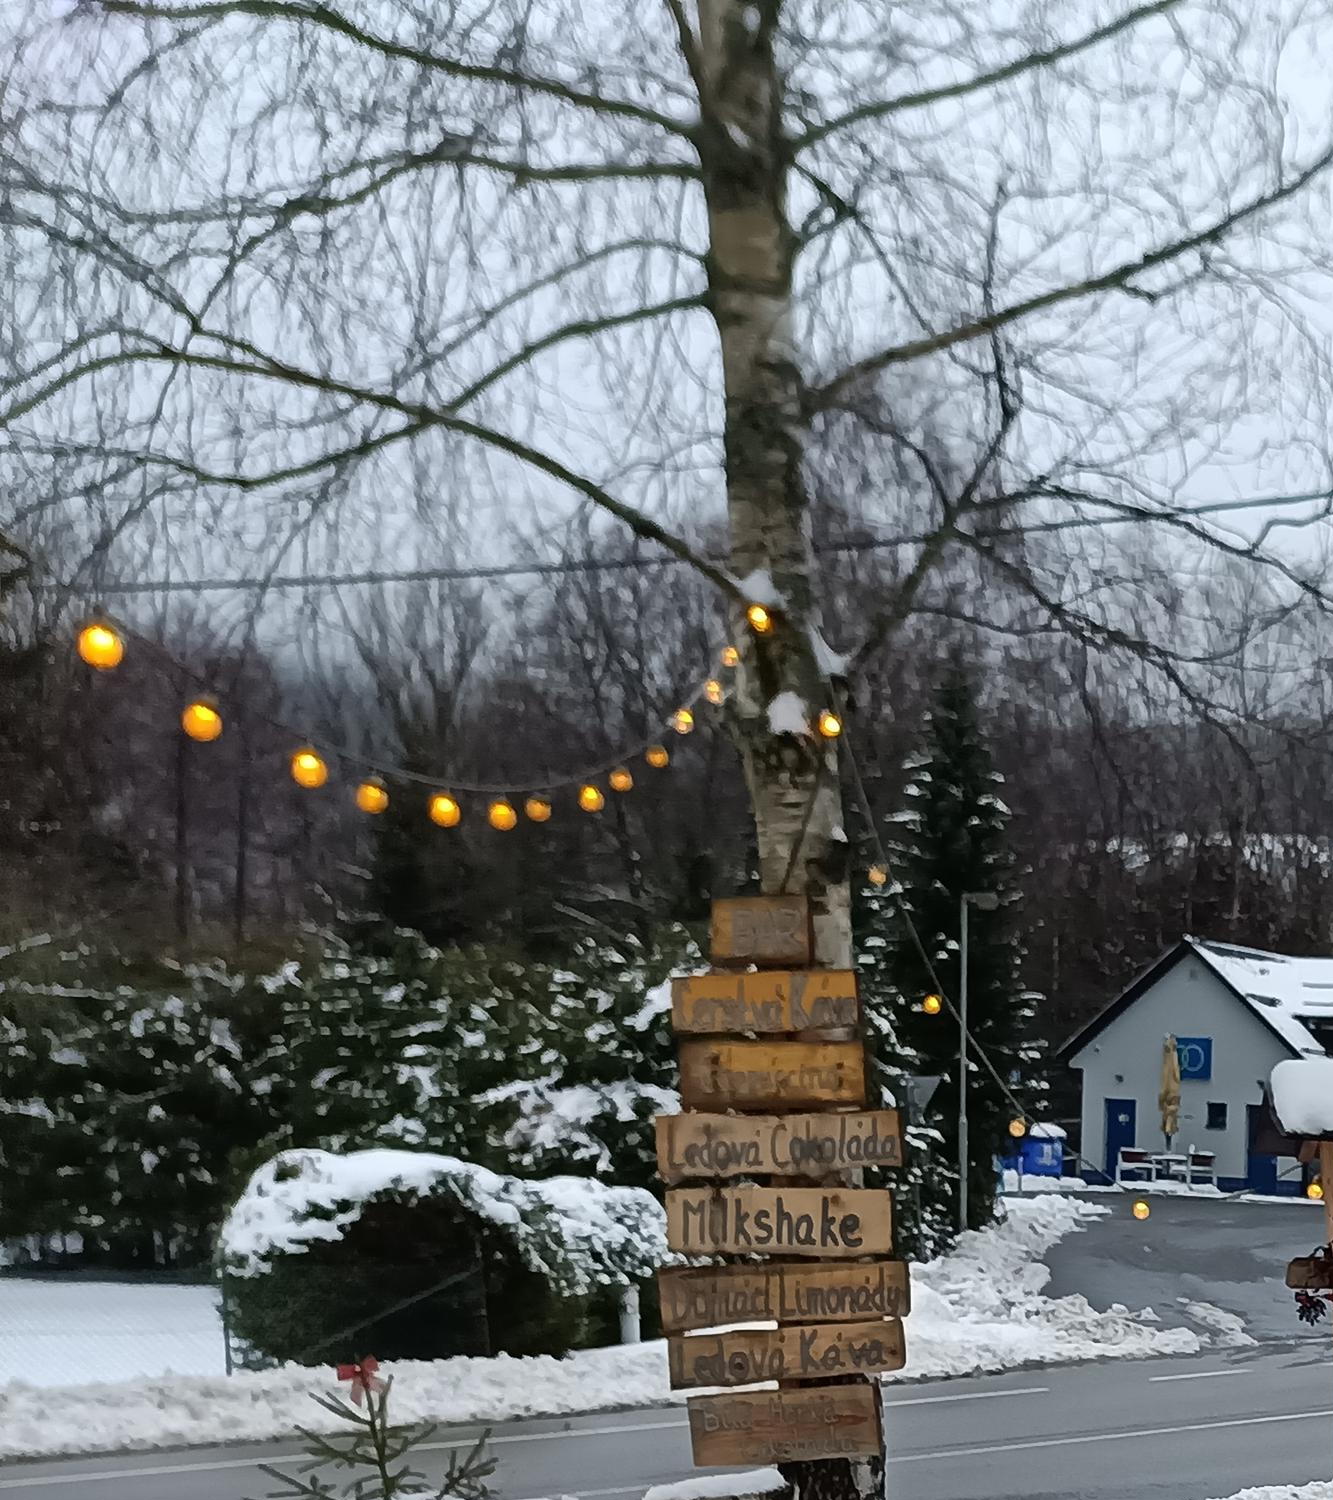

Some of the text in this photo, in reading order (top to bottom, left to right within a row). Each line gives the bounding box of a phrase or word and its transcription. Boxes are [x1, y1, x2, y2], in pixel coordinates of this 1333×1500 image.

[667, 1117, 763, 1169] Ledová
[683, 1194, 864, 1248] Milkshake
[779, 1267, 902, 1319] Limonády
[678, 1330, 888, 1385] Ledová Káva
